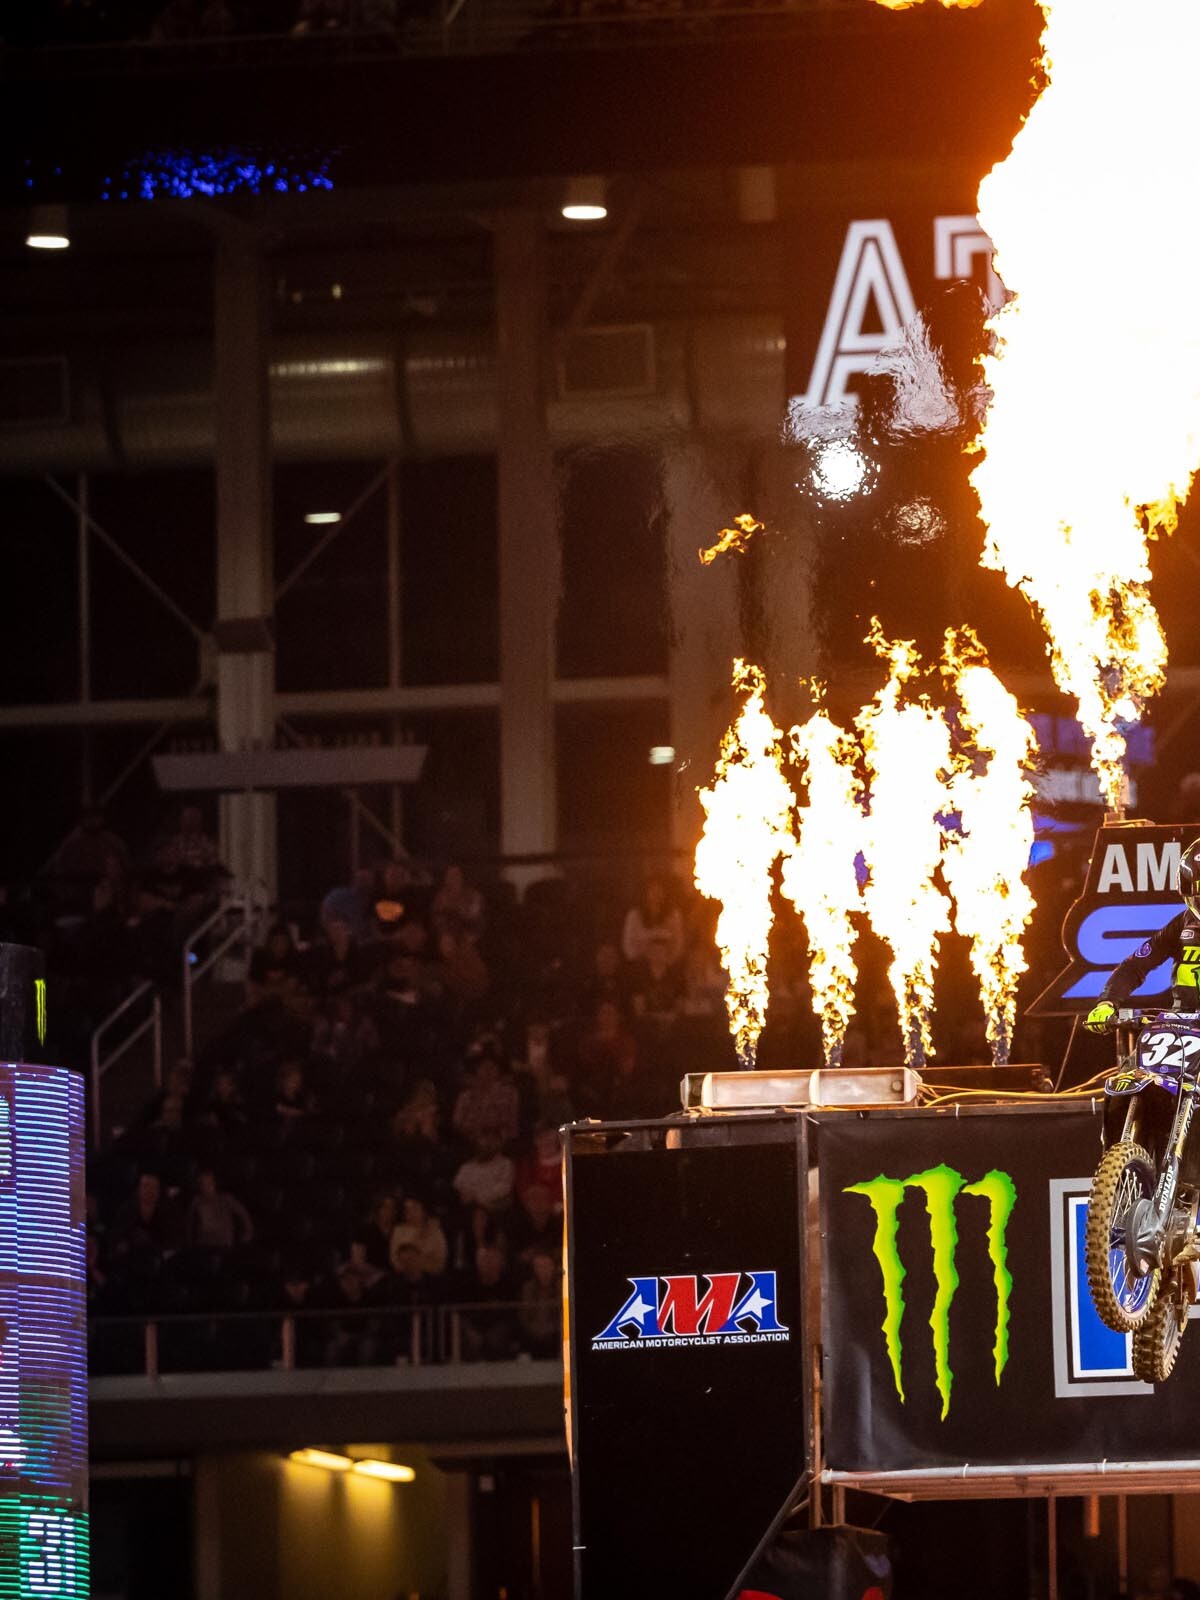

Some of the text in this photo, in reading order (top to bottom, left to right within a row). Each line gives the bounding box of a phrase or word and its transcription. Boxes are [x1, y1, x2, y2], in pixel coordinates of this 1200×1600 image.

[1097, 841, 1182, 894] AM
[1158, 1165, 1175, 1213] DUNLOP
[592, 1270, 790, 1341] AMA
[592, 1333, 790, 1351] AMERICAN MOTORCYCLIST ASSOCIATION
